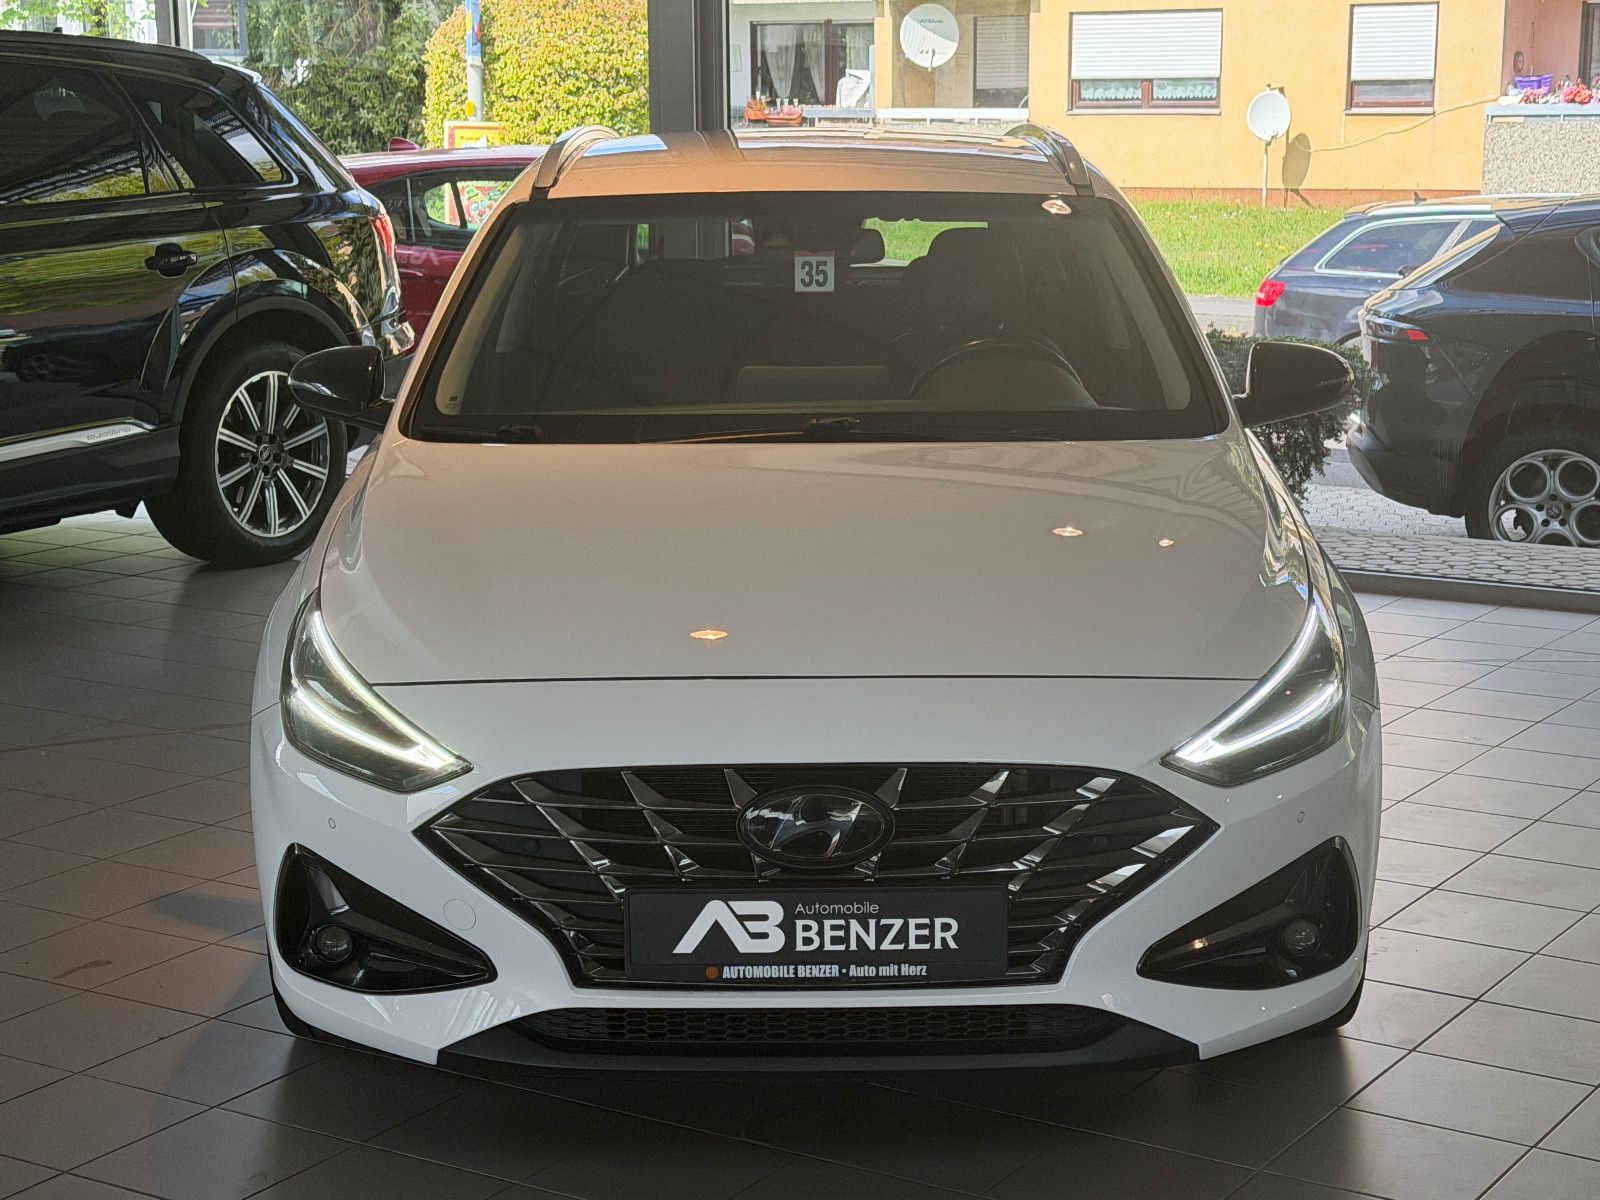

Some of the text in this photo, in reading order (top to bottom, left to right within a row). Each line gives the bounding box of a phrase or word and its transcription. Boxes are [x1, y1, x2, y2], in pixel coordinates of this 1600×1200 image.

[800, 260, 829, 288] 35
[794, 901, 880, 915] Automobile
[794, 917, 960, 952] BENZER
[722, 962, 928, 980] AUTOMOBILE BENZER Auto mit Herz
